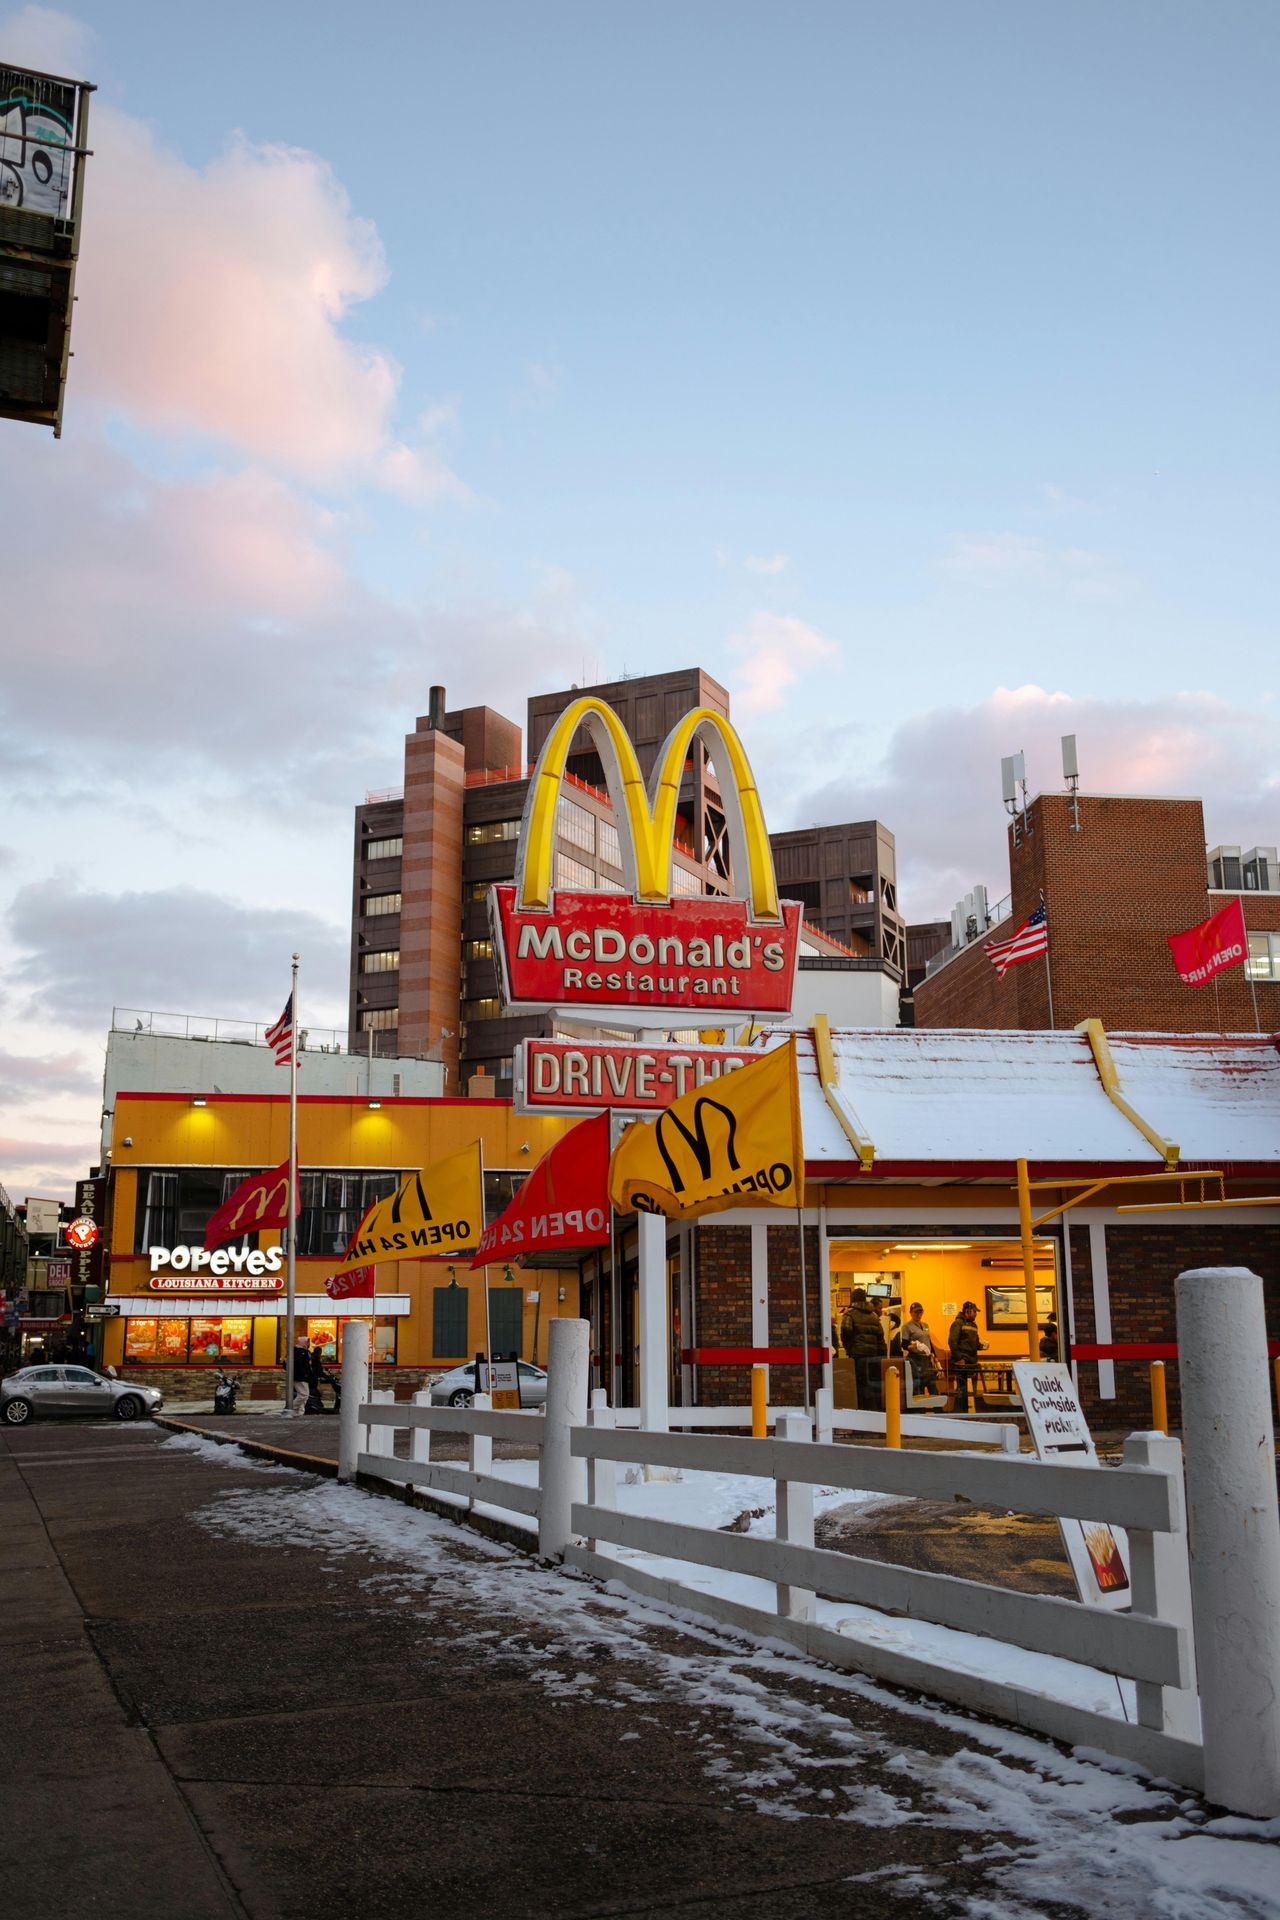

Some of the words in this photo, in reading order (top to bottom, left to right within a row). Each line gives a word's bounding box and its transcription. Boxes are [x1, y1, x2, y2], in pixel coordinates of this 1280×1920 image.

[516, 924, 785, 971] McDonald's
[562, 968, 741, 996] Restaurant
[81, 1184, 95, 1218] BEAU
[50, 1264, 70, 1278] DELI
[78, 1250, 92, 1282] PPLY
[158, 1279, 219, 1288] LOUISIANA
[222, 1279, 277, 1288] KITCHEN
[1032, 1375, 1064, 1396] Quick
[1031, 1395, 1077, 1413] Curbside
